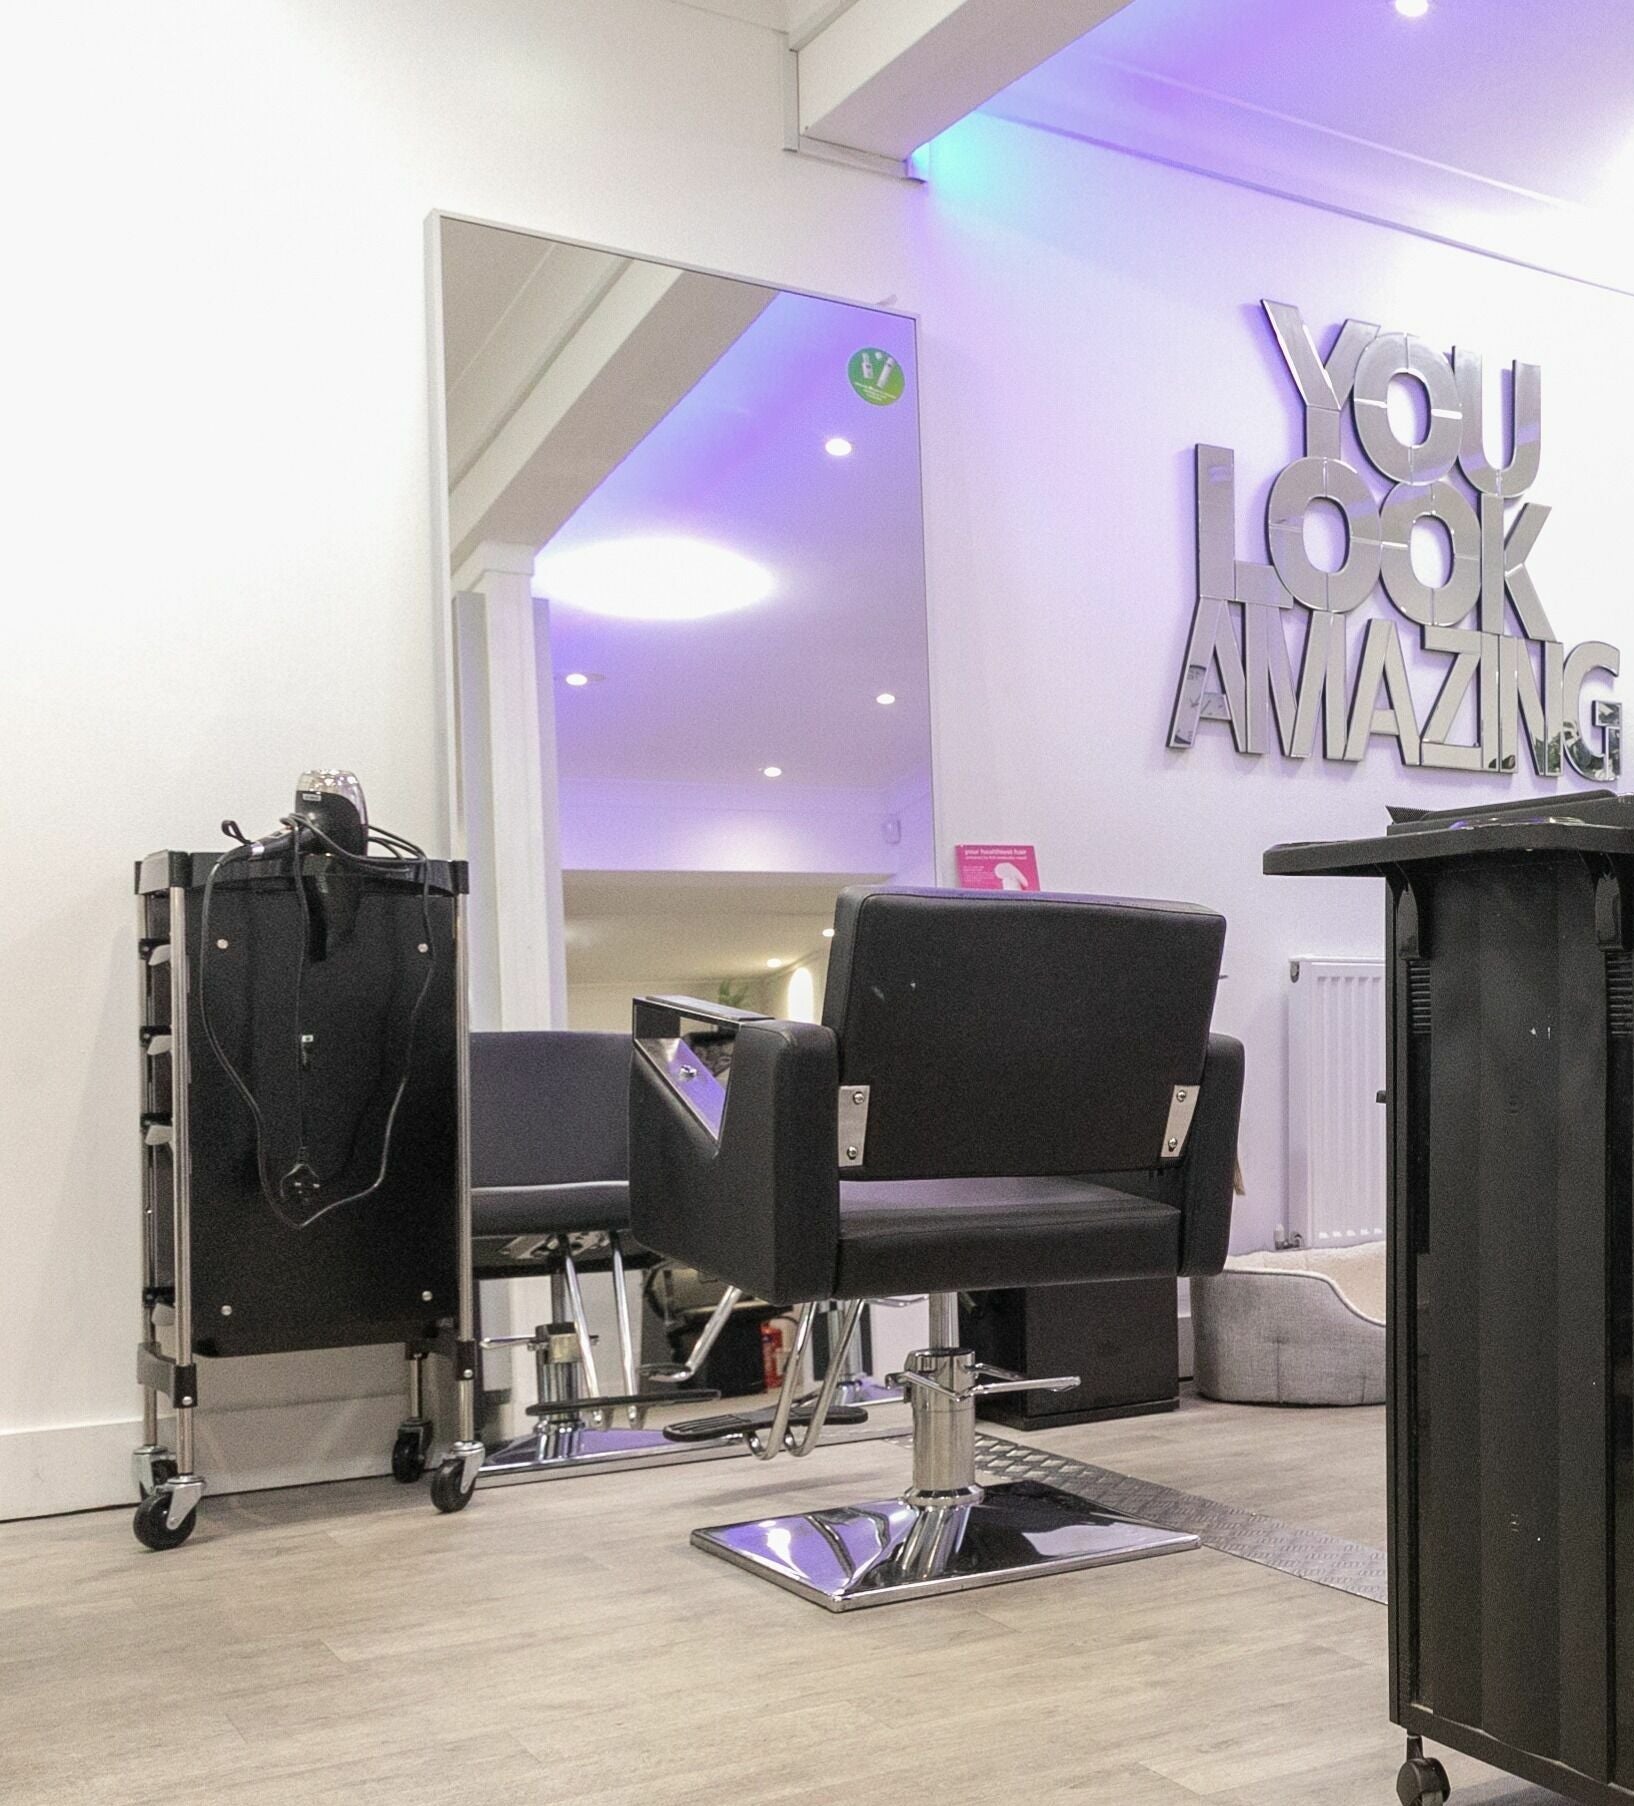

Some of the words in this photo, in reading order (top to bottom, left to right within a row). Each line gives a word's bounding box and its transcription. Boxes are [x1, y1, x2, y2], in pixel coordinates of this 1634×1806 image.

[1260, 298, 1542, 497] YOU
[1194, 443, 1558, 642] LOOK
[1165, 596, 1623, 781] AMAZING
